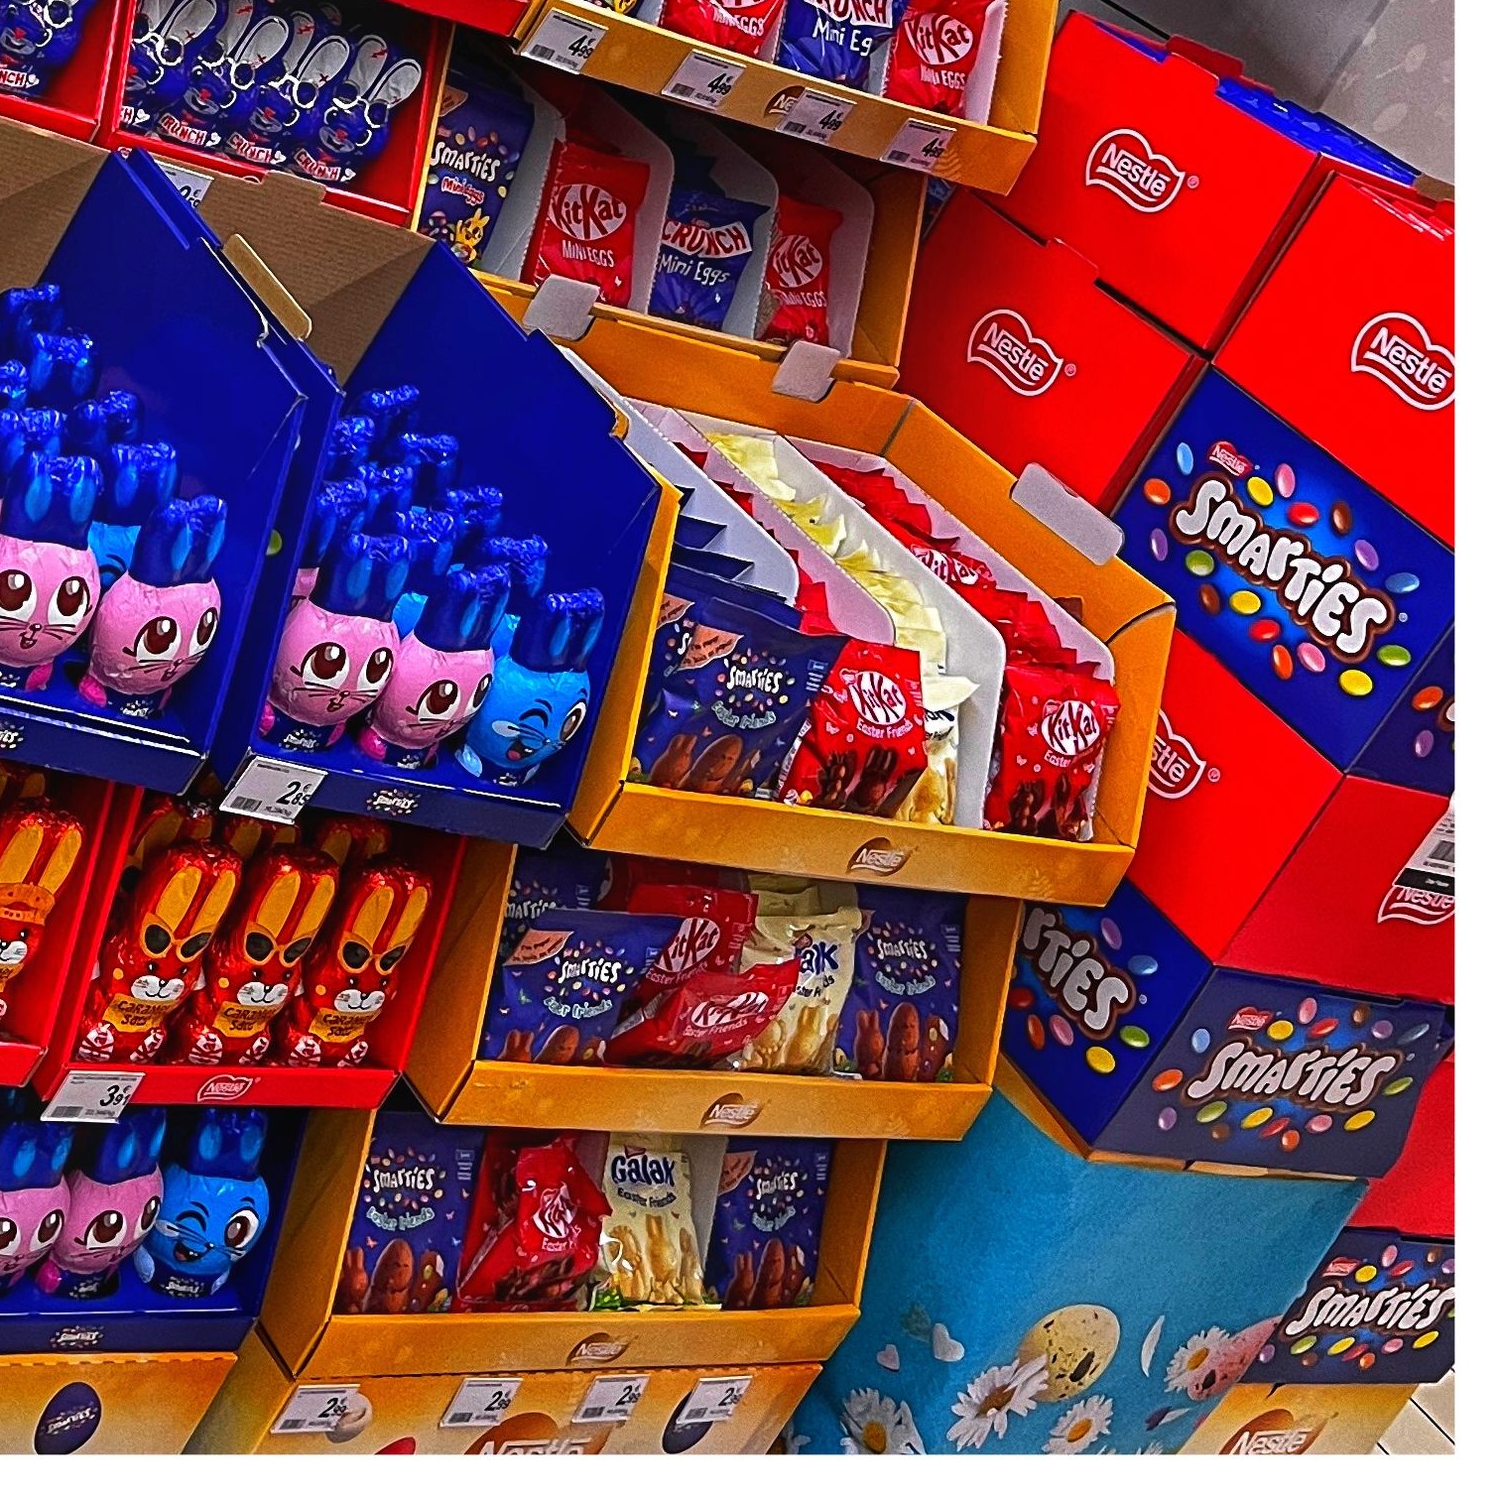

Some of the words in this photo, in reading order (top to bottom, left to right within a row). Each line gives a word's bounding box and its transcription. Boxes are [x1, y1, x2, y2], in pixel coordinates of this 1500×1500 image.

[907, 16, 972, 65] KitKat
[550, 186, 626, 238] KitKat
[562, 239, 584, 261] MINI
[585, 244, 614, 268] EGGS
[663, 221, 746, 257] CRUNCH
[661, 255, 691, 276] Mini
[695, 262, 730, 284] Eggs
[852, 670, 905, 725] KitKat
[856, 719, 883, 738] Easter
[1043, 701, 1101, 754] KitKat
[657, 918, 718, 971] KitKat
[617, 1187, 646, 1204] Easter
